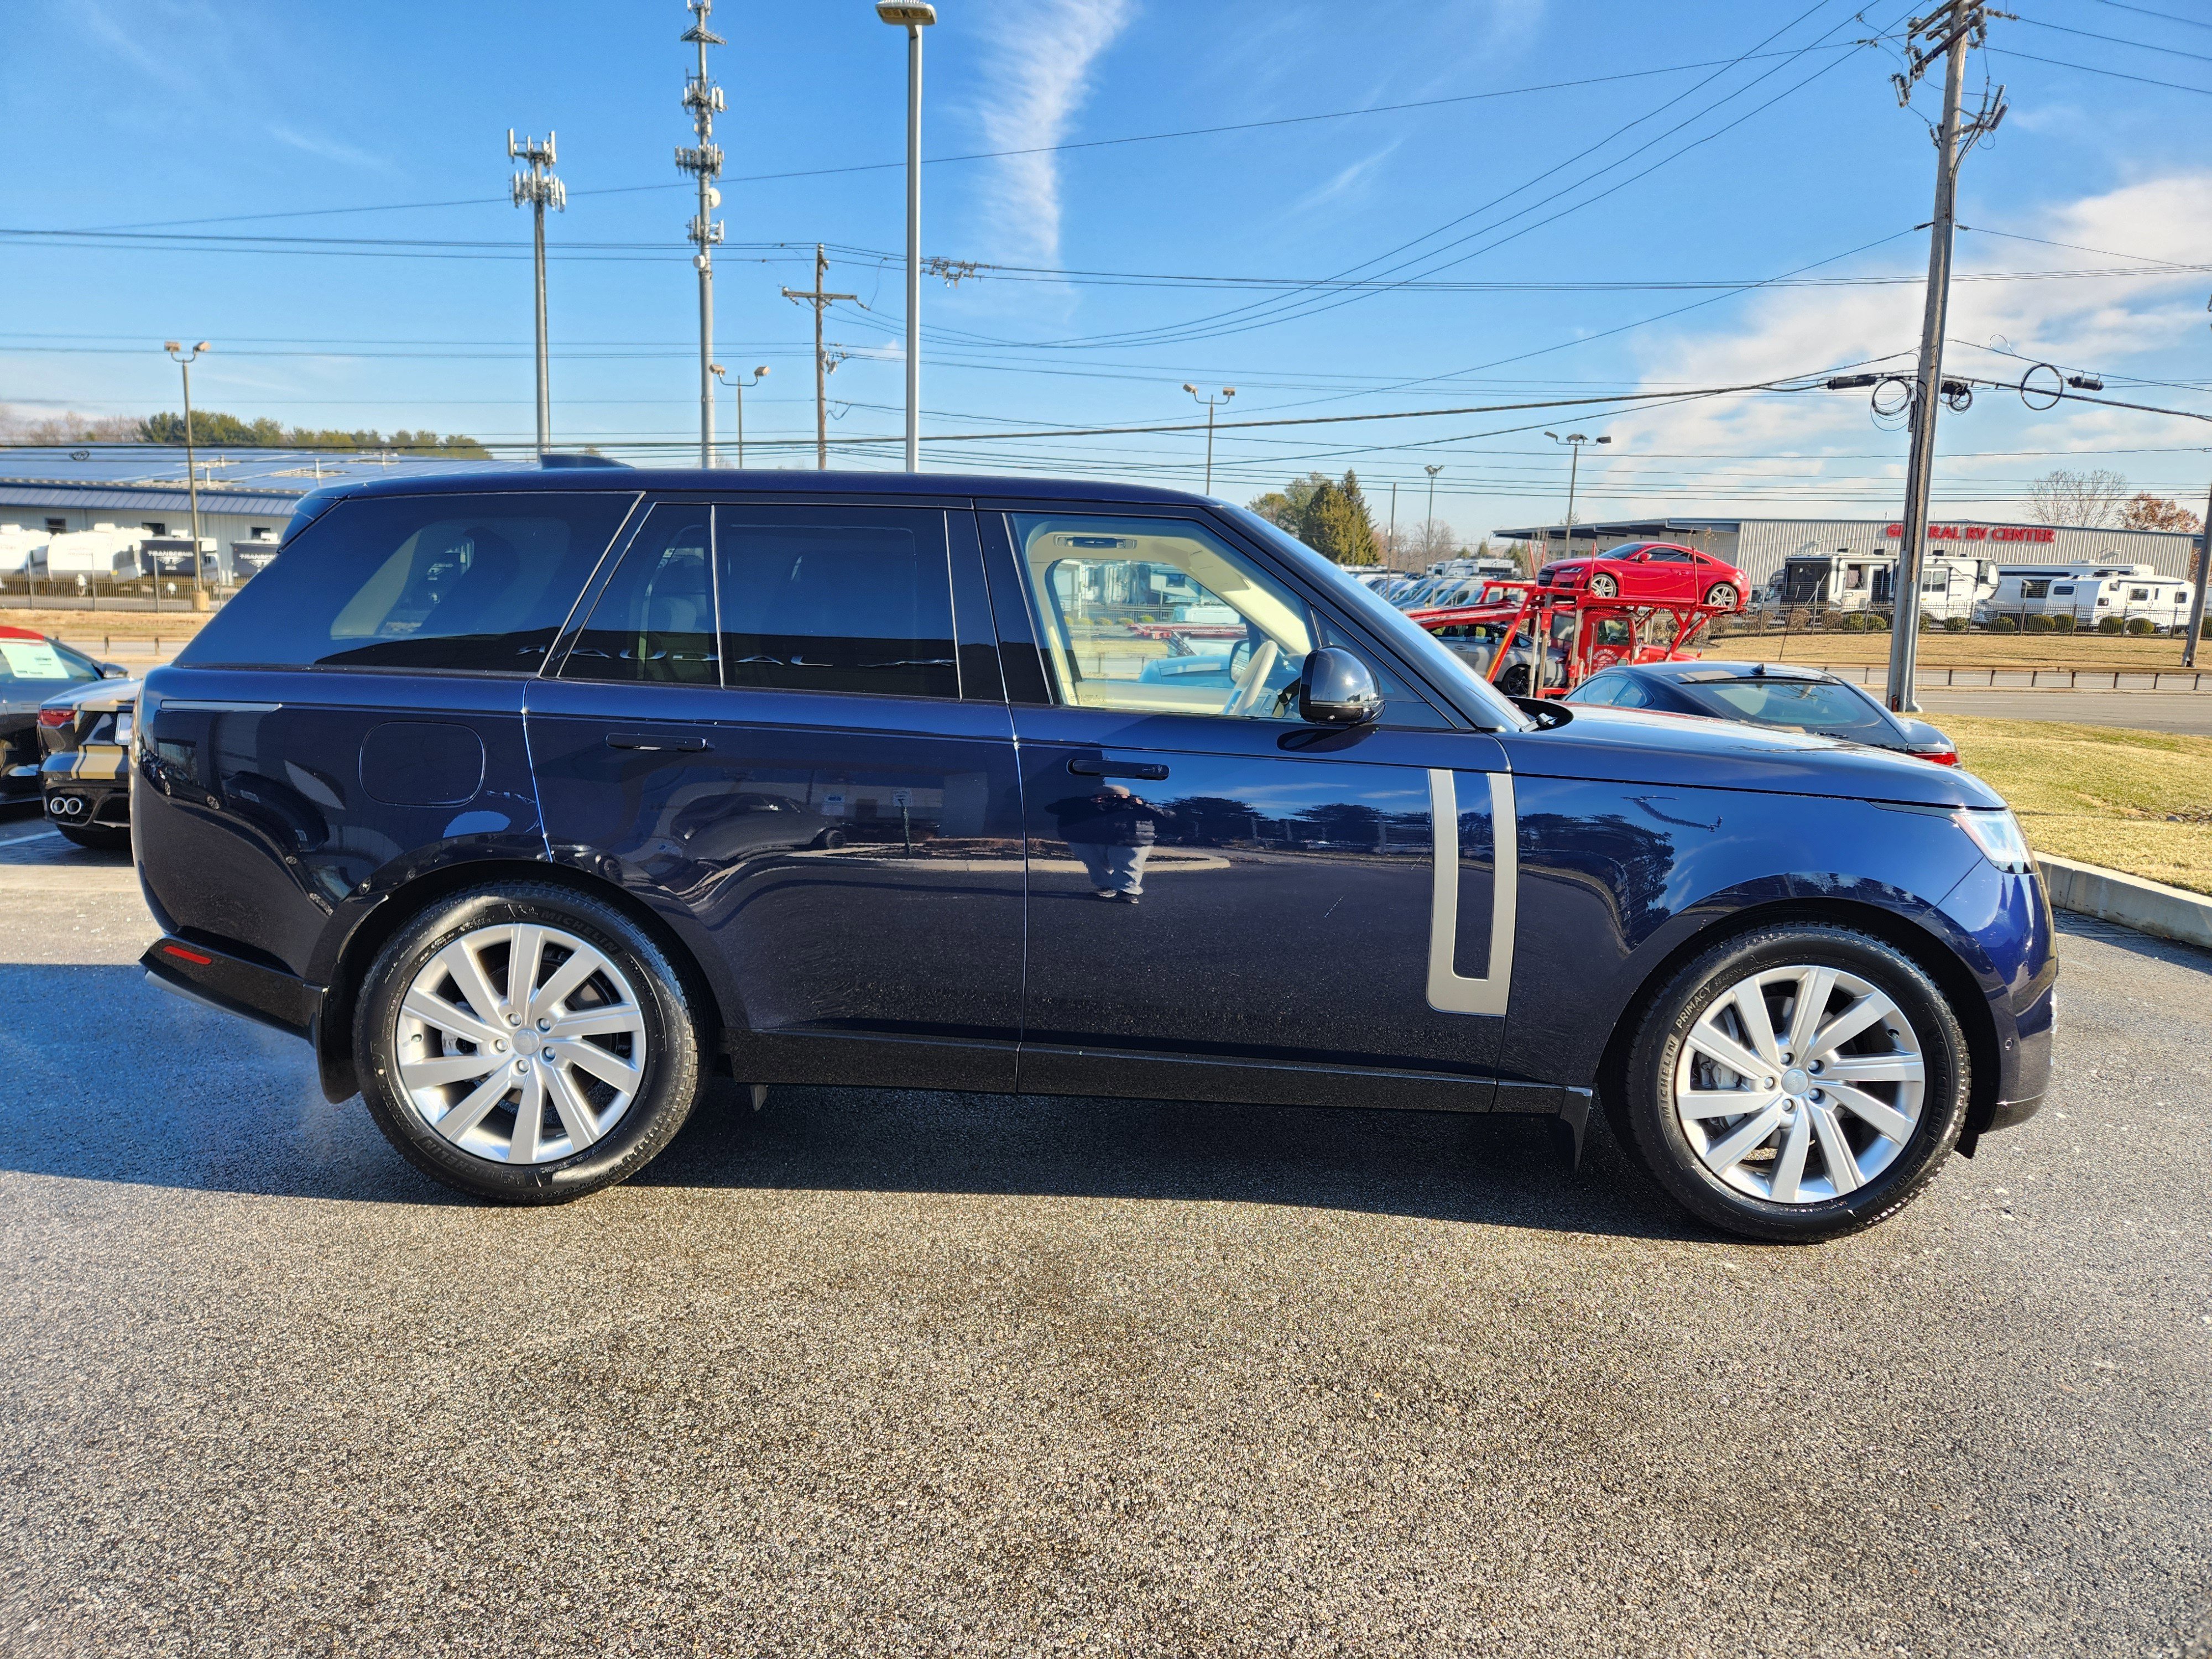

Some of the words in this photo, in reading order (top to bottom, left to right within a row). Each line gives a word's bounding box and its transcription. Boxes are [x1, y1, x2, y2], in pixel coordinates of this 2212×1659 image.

[1887, 524, 1961, 540] GRAL
[1966, 527, 1988, 541] RV
[1992, 528, 2055, 542] CENTER
[1660, 1038, 1678, 1120] MICHELIN
[1675, 982, 1712, 1029] PRIMACY
